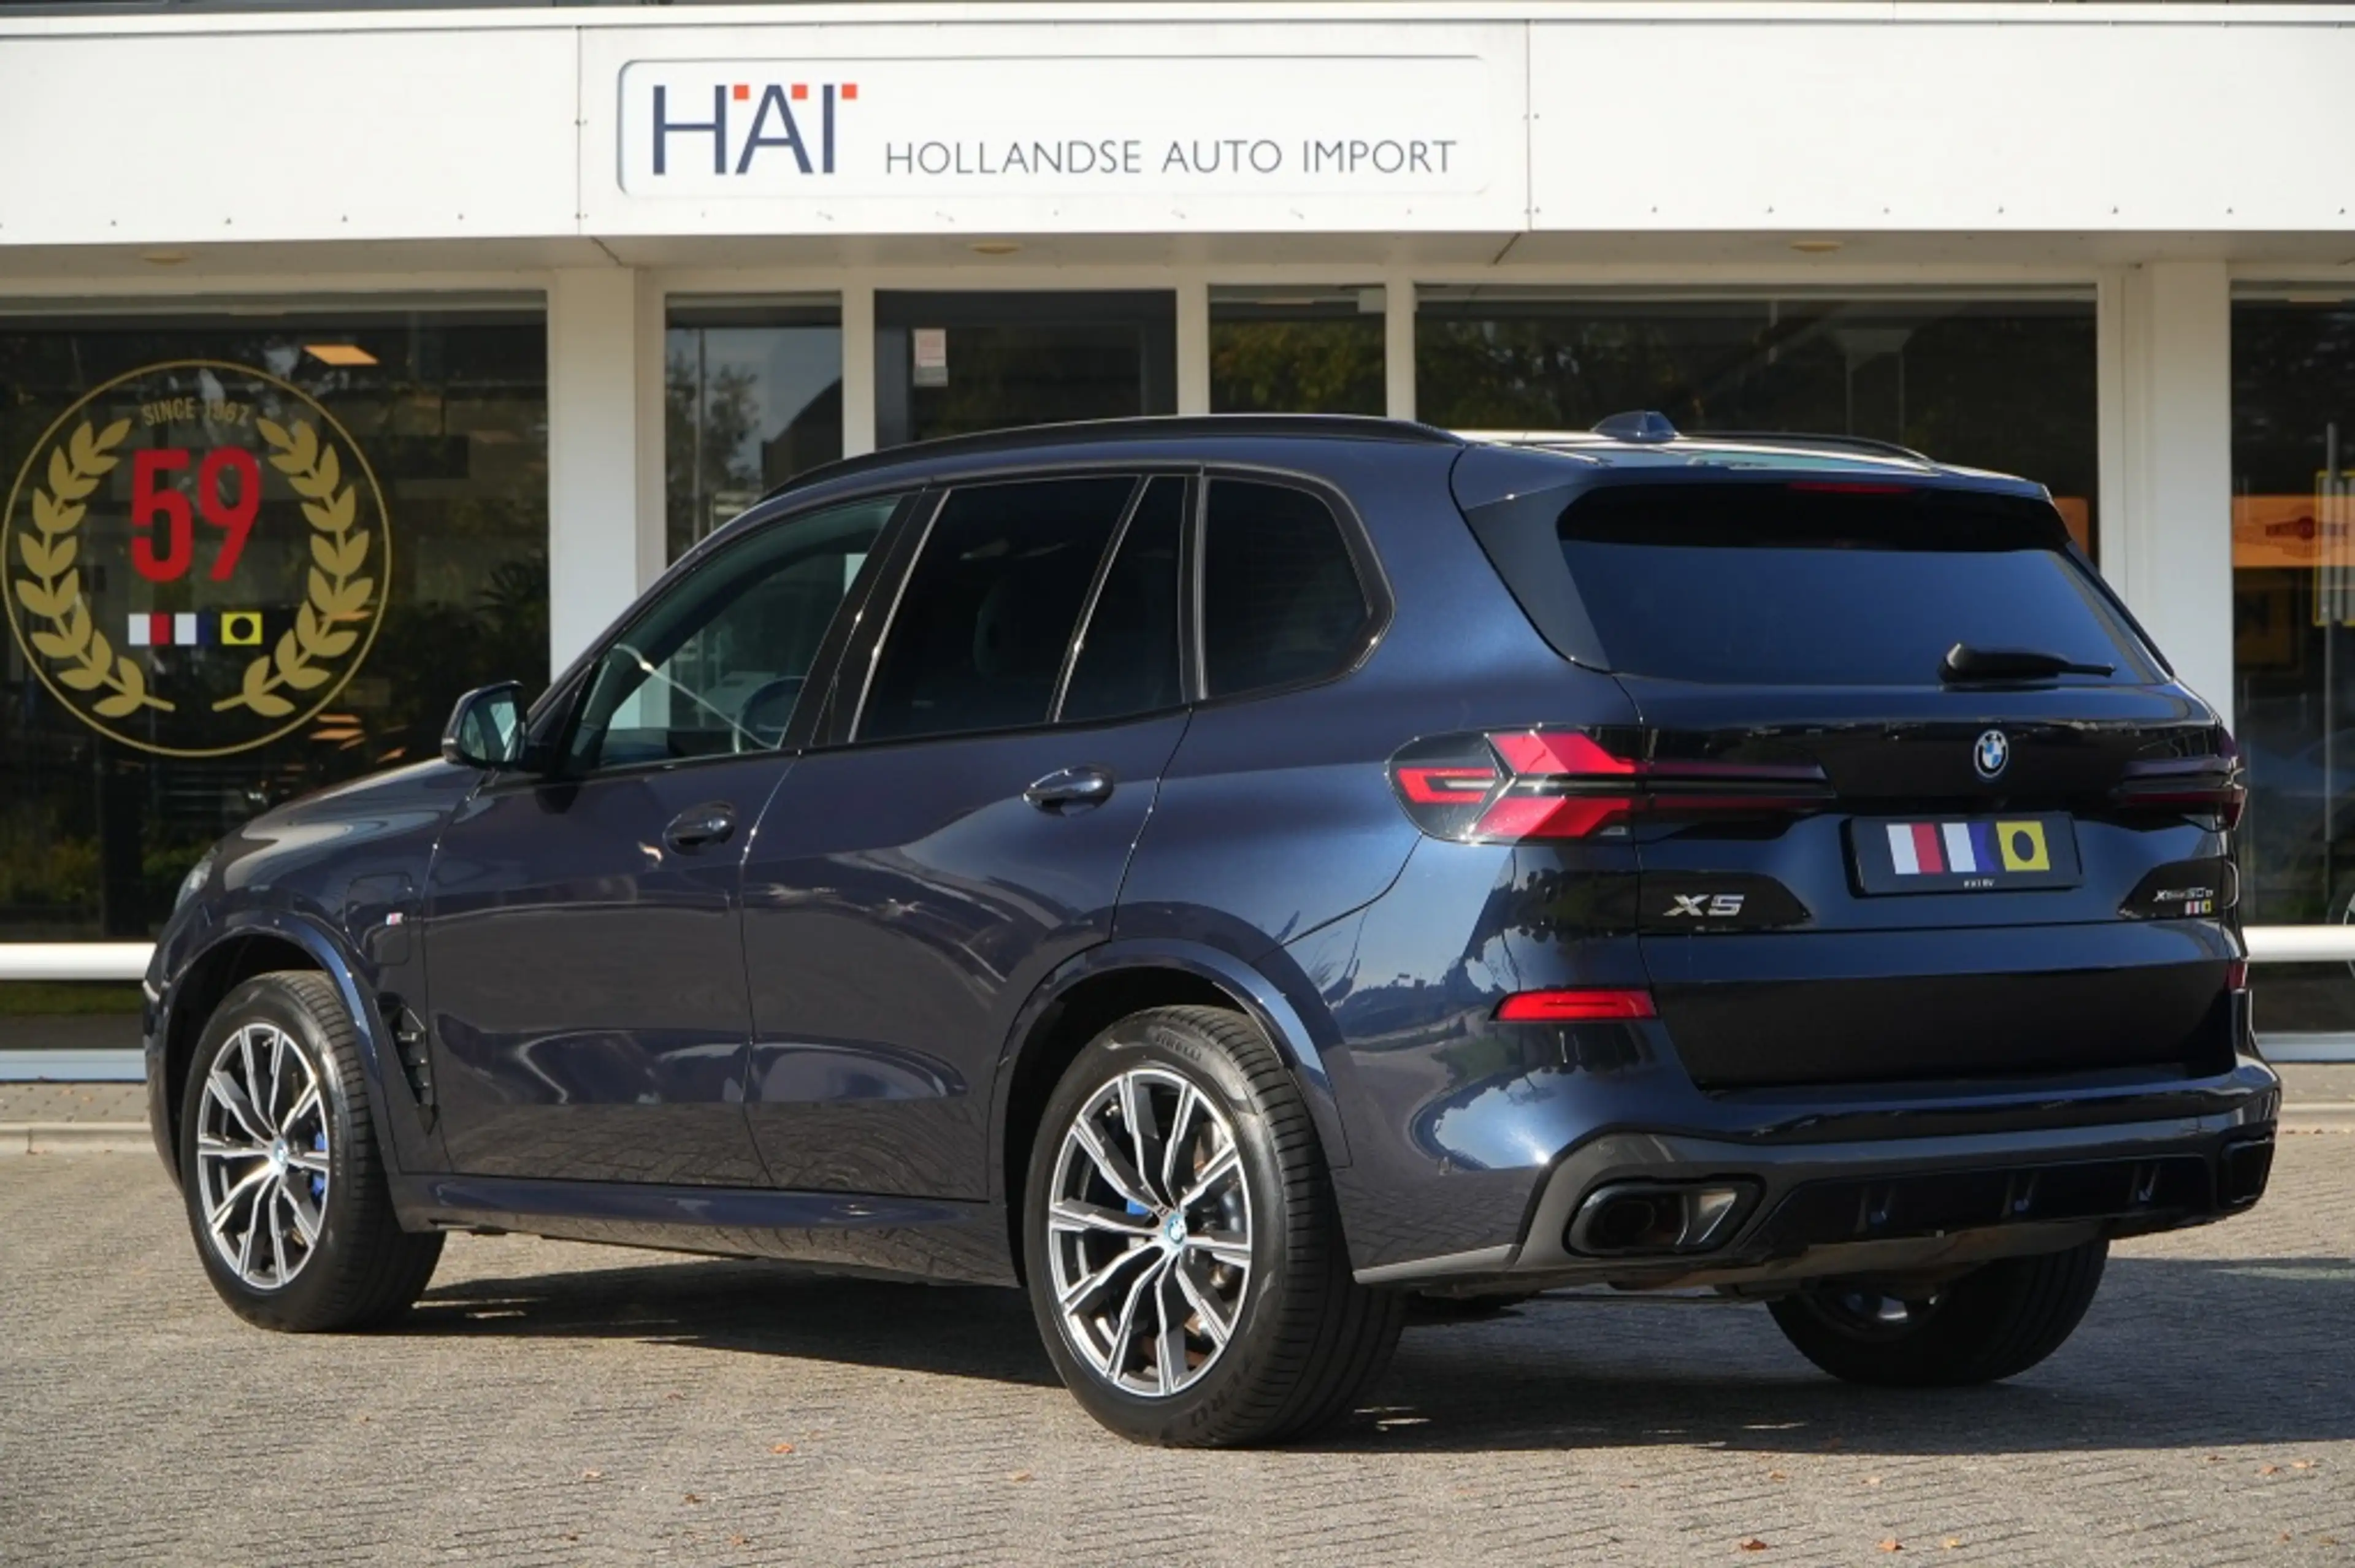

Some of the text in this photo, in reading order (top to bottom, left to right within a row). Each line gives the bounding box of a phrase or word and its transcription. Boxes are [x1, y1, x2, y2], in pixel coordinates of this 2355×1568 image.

[886, 139, 1457, 174] HOLLANDSE AUTO IMPORT
[141, 397, 196, 426] SINCE
[131, 445, 262, 582] 59
[1663, 894, 1744, 916] X5
